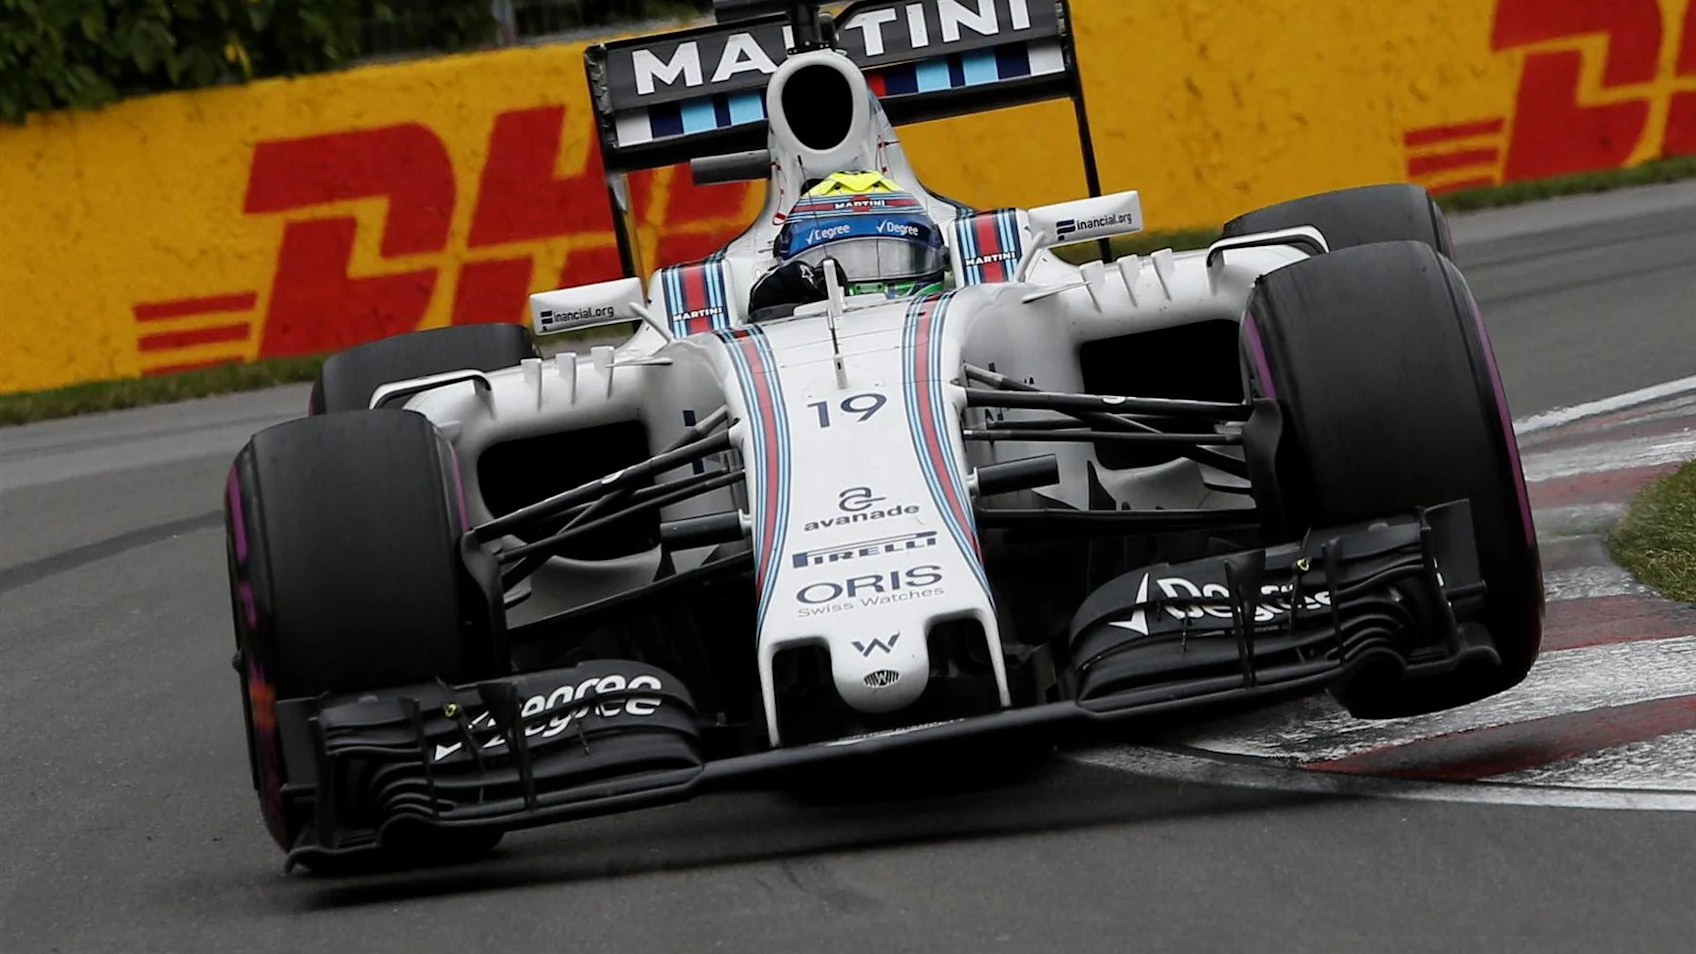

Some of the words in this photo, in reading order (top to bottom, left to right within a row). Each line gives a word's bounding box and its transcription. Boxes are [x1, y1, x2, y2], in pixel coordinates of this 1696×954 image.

[887, 221, 919, 237] Degree
[965, 251, 1020, 268] MARTINI
[672, 306, 724, 322] MARTINI
[807, 393, 888, 429] 19
[804, 503, 921, 532] avanade
[792, 531, 938, 569] PIRELLI
[796, 565, 944, 605] ORIS
[797, 601, 855, 618] Swiss
[861, 585, 945, 607] Watches
[482, 673, 662, 749] egree
